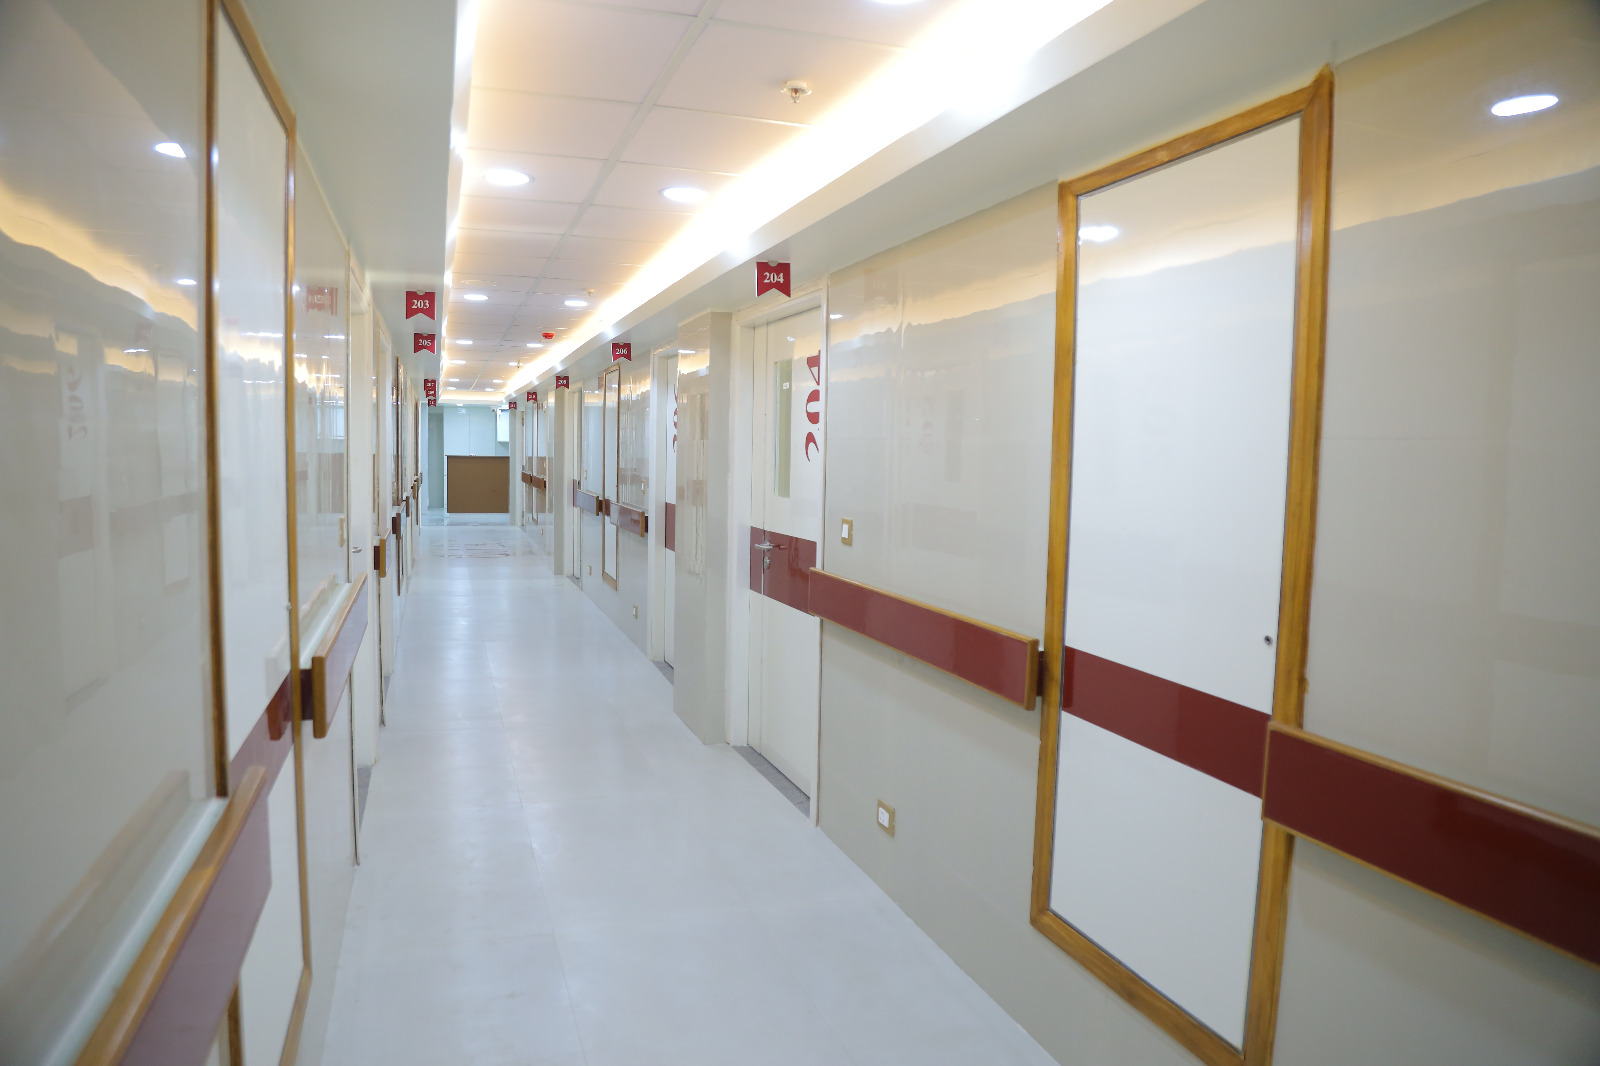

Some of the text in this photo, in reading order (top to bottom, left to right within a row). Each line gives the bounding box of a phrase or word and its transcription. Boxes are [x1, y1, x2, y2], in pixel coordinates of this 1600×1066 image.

[763, 272, 785, 284] 204
[411, 299, 430, 309] 203
[418, 339, 432, 347] 205
[615, 347, 628, 355] 206
